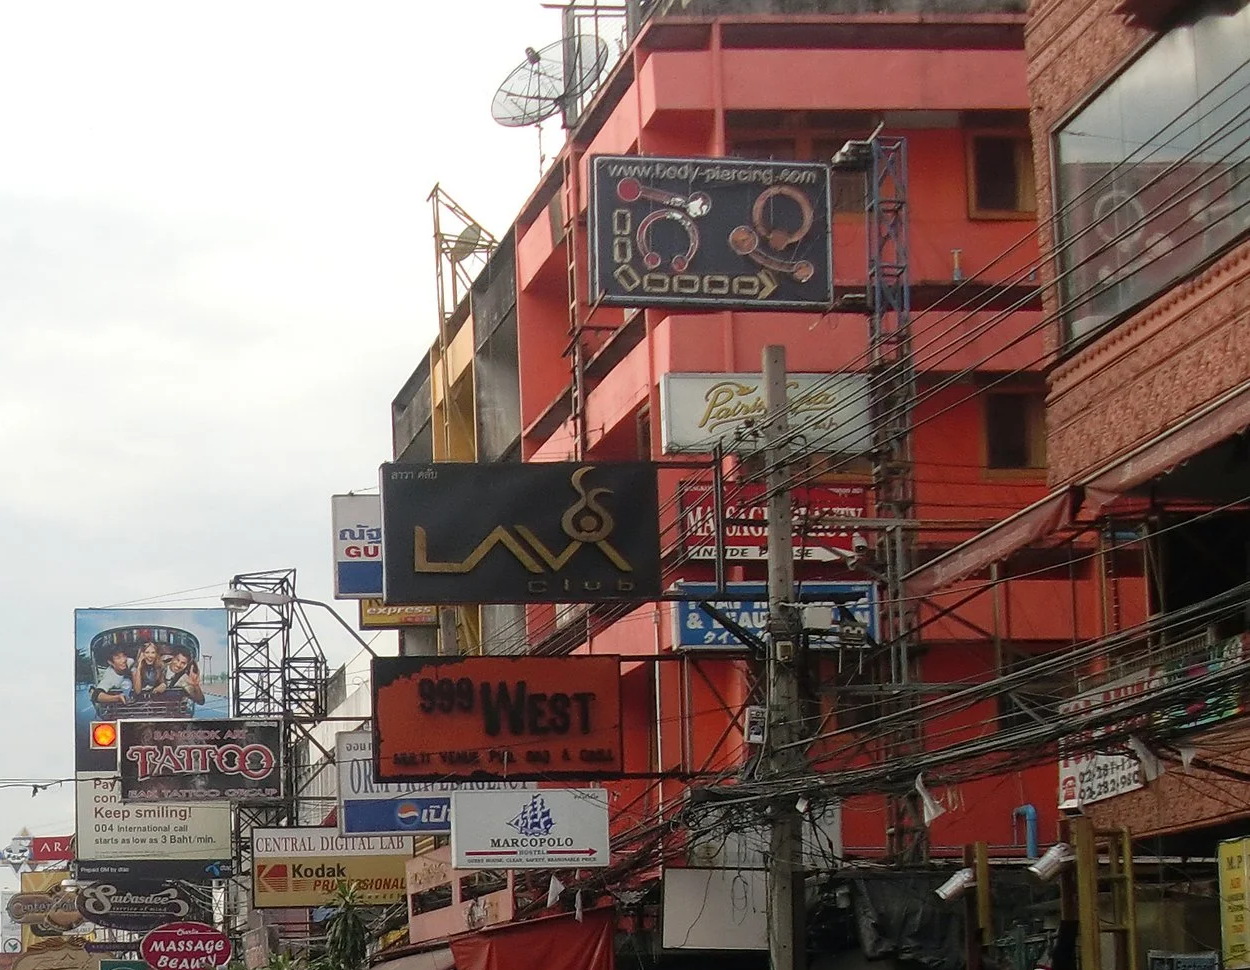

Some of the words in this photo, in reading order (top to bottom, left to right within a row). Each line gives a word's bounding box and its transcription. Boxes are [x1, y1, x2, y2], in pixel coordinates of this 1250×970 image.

[607, 162, 817, 187] www.body-piercing.com
[366, 605, 432, 617] express
[418, 676, 475, 715] 999
[126, 743, 275, 782] TATTOO
[93, 778, 117, 792] Pay
[93, 806, 131, 821] Keep
[134, 806, 193, 821] smiling!
[94, 823, 114, 833] 004
[117, 824, 171, 833] International
[173, 824, 188, 833] call
[94, 836, 119, 845] starts
[120, 837, 131, 845] as
[131, 836, 147, 845] low
[148, 837, 159, 845] as
[160, 835, 167, 844] 3
[255, 835, 316, 853] CENTRAL
[319, 834, 376, 852] DIGITAL
[379, 834, 405, 850] LAB
[489, 836, 574, 849] MARCOPOLO
[518, 849, 547, 857] HOSTEL
[291, 863, 347, 879] Kodak
[82, 884, 190, 917] Sawasdee
[149, 939, 226, 954] MASSAGE
